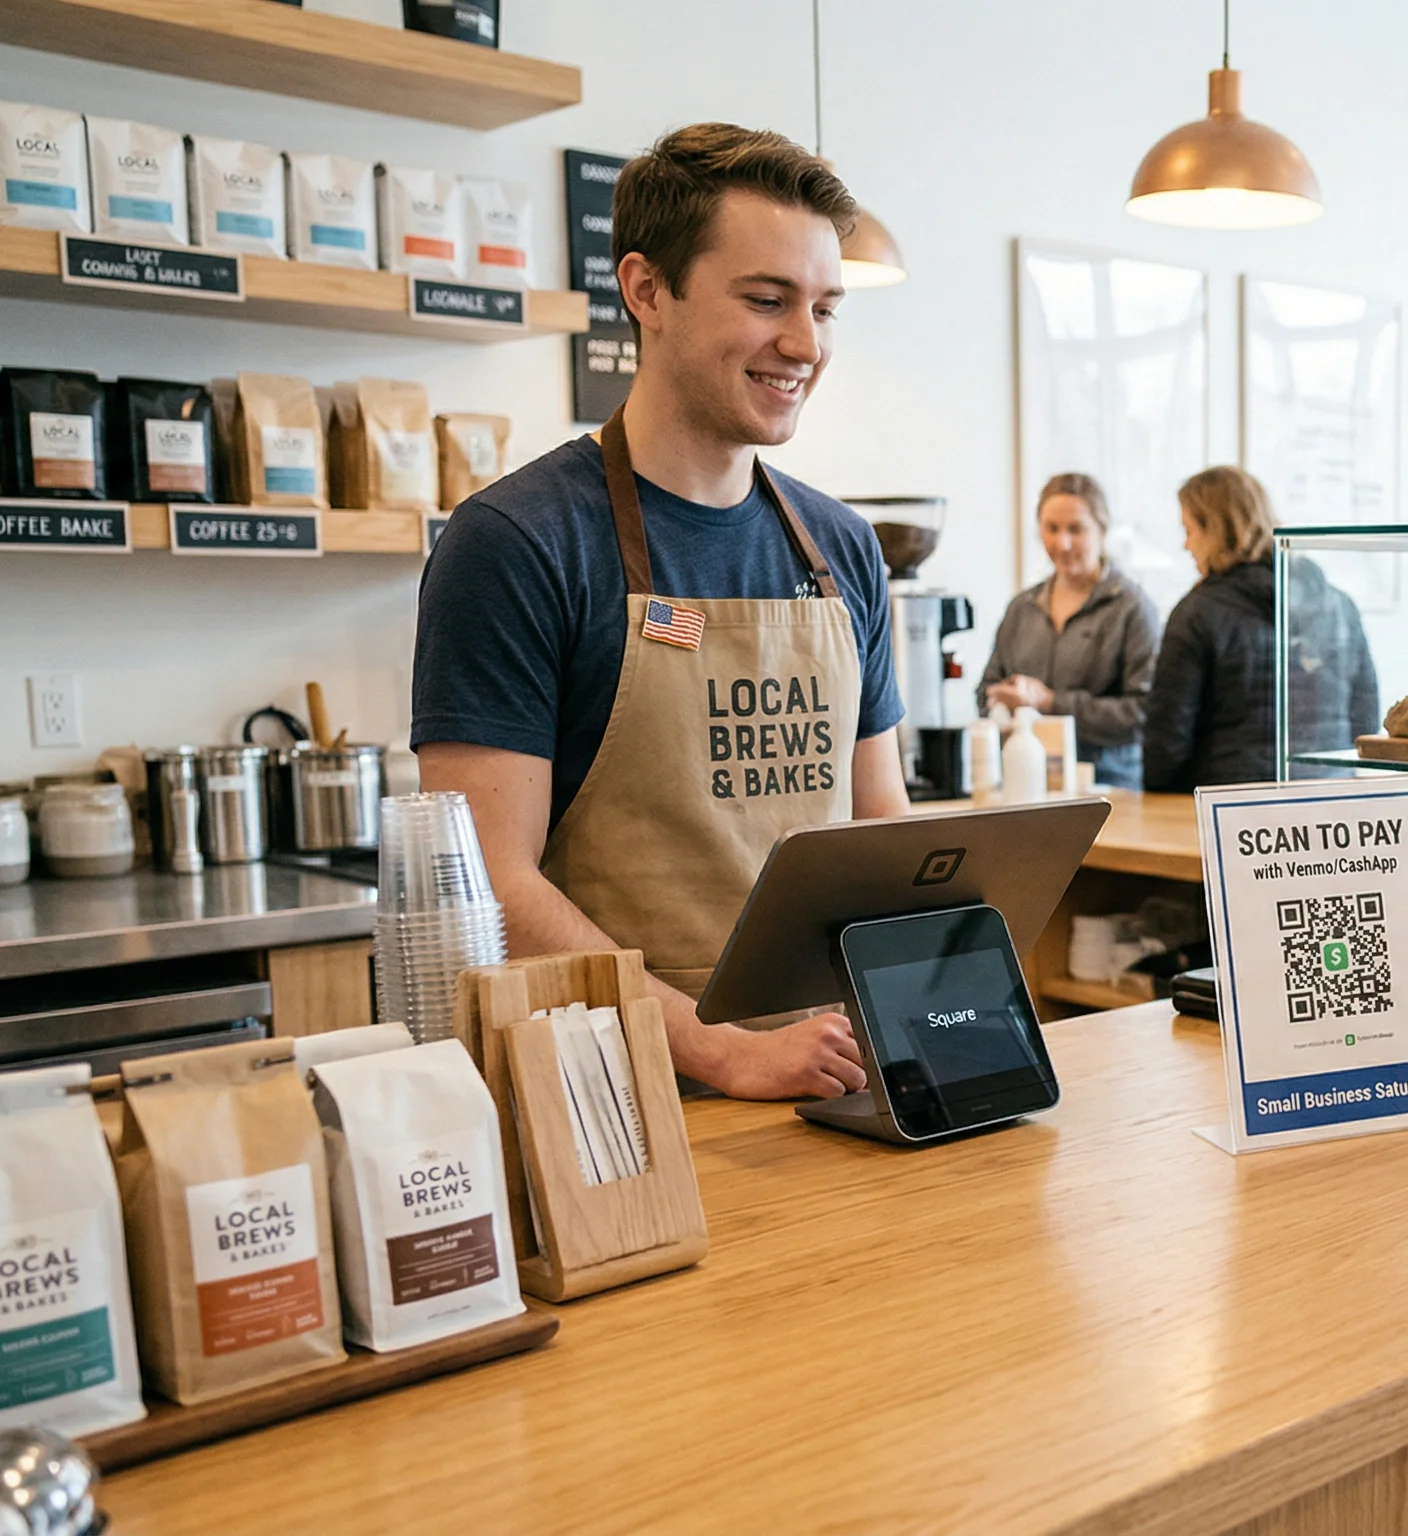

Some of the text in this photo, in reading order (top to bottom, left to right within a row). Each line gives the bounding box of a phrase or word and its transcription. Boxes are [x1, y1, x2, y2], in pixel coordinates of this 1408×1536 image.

[16, 137, 60, 152] LOCAL
[118, 156, 159, 170] LOCAL
[0, 515, 113, 538] OFFEE BAAKE
[707, 676, 829, 717] LOCAL
[709, 720, 833, 762] BREWS
[711, 762, 834, 799] & BAKES
[1238, 819, 1402, 856] SCAN TO PAY
[1253, 855, 1397, 880] with Venmo/CashApp
[927, 1009, 977, 1029] Square
[1257, 1092, 1300, 1115] Small
[1304, 1087, 1372, 1109] Business
[399, 1161, 469, 1189] LOCAL
[403, 1179, 472, 1207] BREWS
[214, 1201, 294, 1231] LOCAL
[218, 1220, 295, 1250] BREWS
[0, 1247, 78, 1278] OCAL
[0, 1267, 80, 1299] REWS
